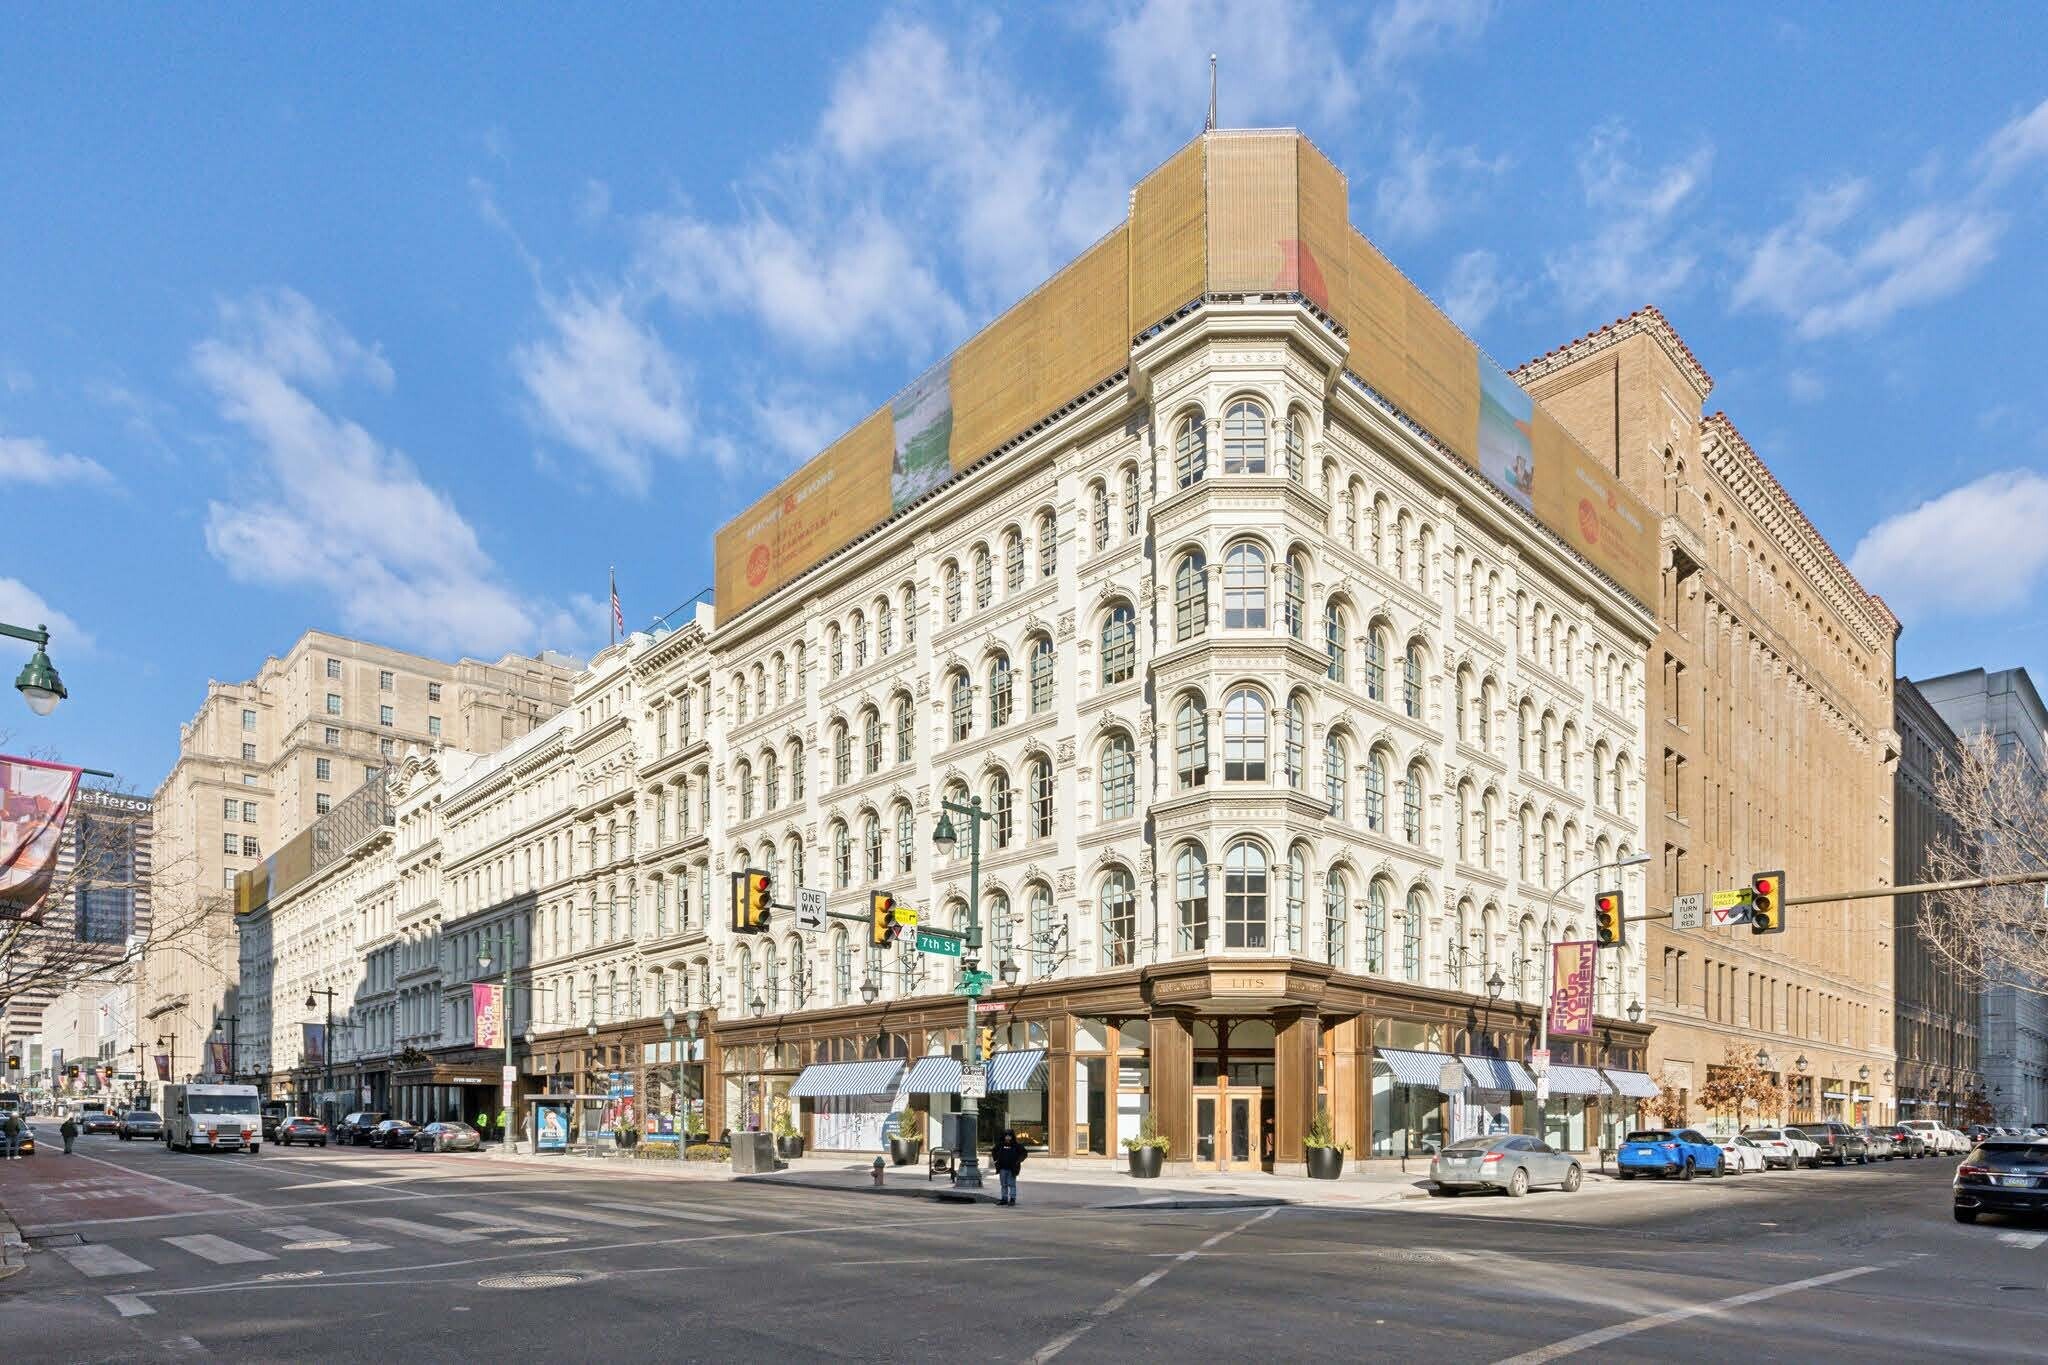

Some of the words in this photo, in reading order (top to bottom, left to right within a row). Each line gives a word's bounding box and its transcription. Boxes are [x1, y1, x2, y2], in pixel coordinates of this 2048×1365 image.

[801, 892, 820, 904] ONE
[1681, 897, 1696, 905] NO
[801, 903, 821, 914] WAY
[1679, 905, 1698, 913] TURN
[921, 937, 940, 950] 7th
[944, 941, 956, 953] St
[1231, 978, 1264, 989] LITS
[1578, 944, 1592, 1033] ELEMENT
[1567, 973, 1579, 1024] YOUR
[1555, 988, 1568, 1030] FIND
